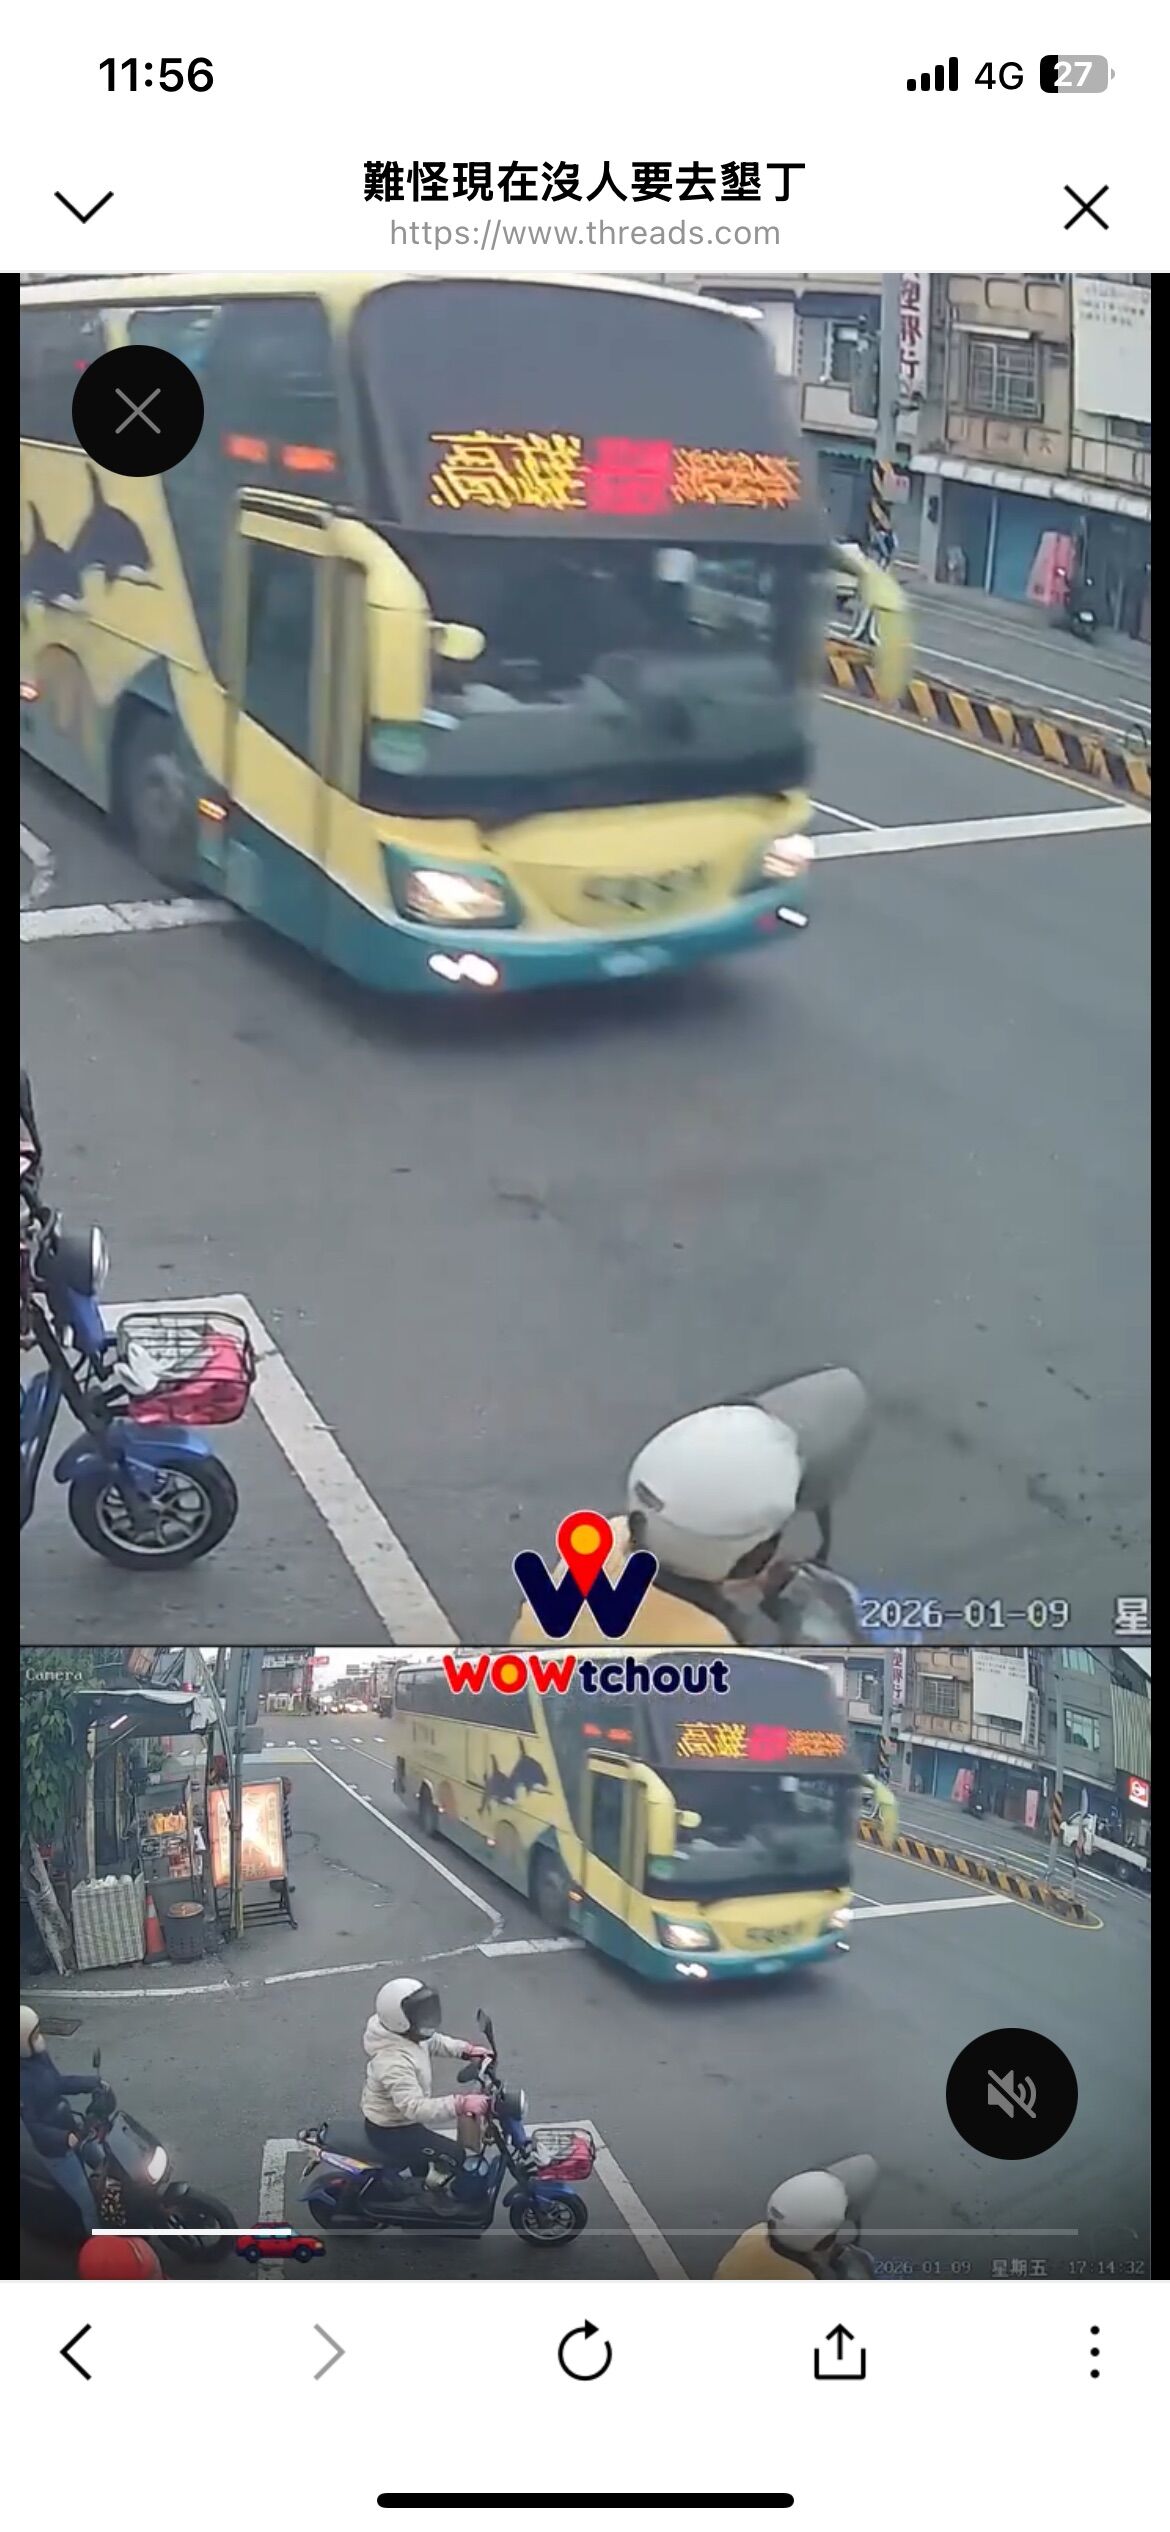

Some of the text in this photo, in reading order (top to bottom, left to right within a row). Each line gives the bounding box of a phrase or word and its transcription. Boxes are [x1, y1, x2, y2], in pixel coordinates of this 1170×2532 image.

[99, 56, 214, 93] 11:56
[974, 61, 1024, 91] 4G
[1053, 61, 1093, 87] 27
[363, 159, 806, 203] 難怪現在沒人要去墾丁
[391, 219, 780, 251] https://www.threads.com
